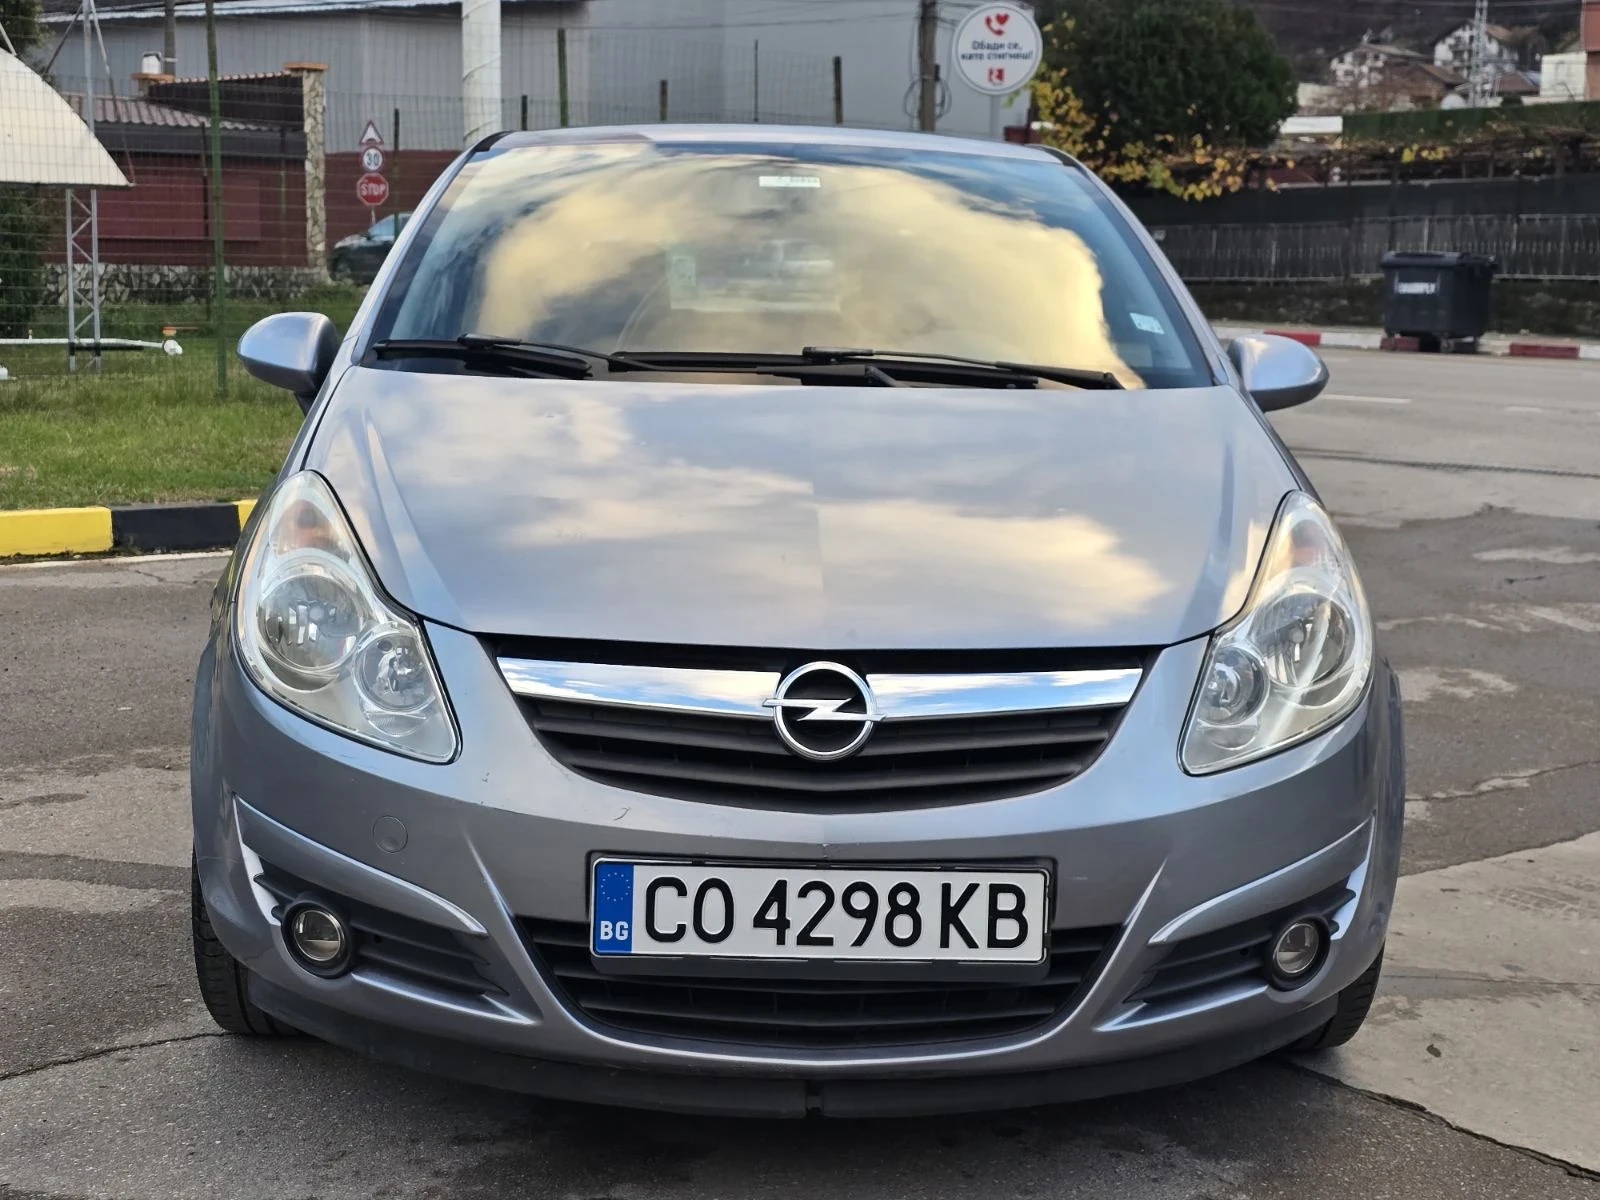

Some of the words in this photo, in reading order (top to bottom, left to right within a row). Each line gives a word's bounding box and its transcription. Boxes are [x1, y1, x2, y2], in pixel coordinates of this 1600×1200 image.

[971, 40, 1005, 50] Обади
[366, 152, 380, 166] 30
[360, 183, 386, 196] STOP
[646, 877, 734, 943] CO
[753, 880, 921, 947] 4298
[940, 883, 1028, 948] KB
[600, 921, 629, 940] BG
